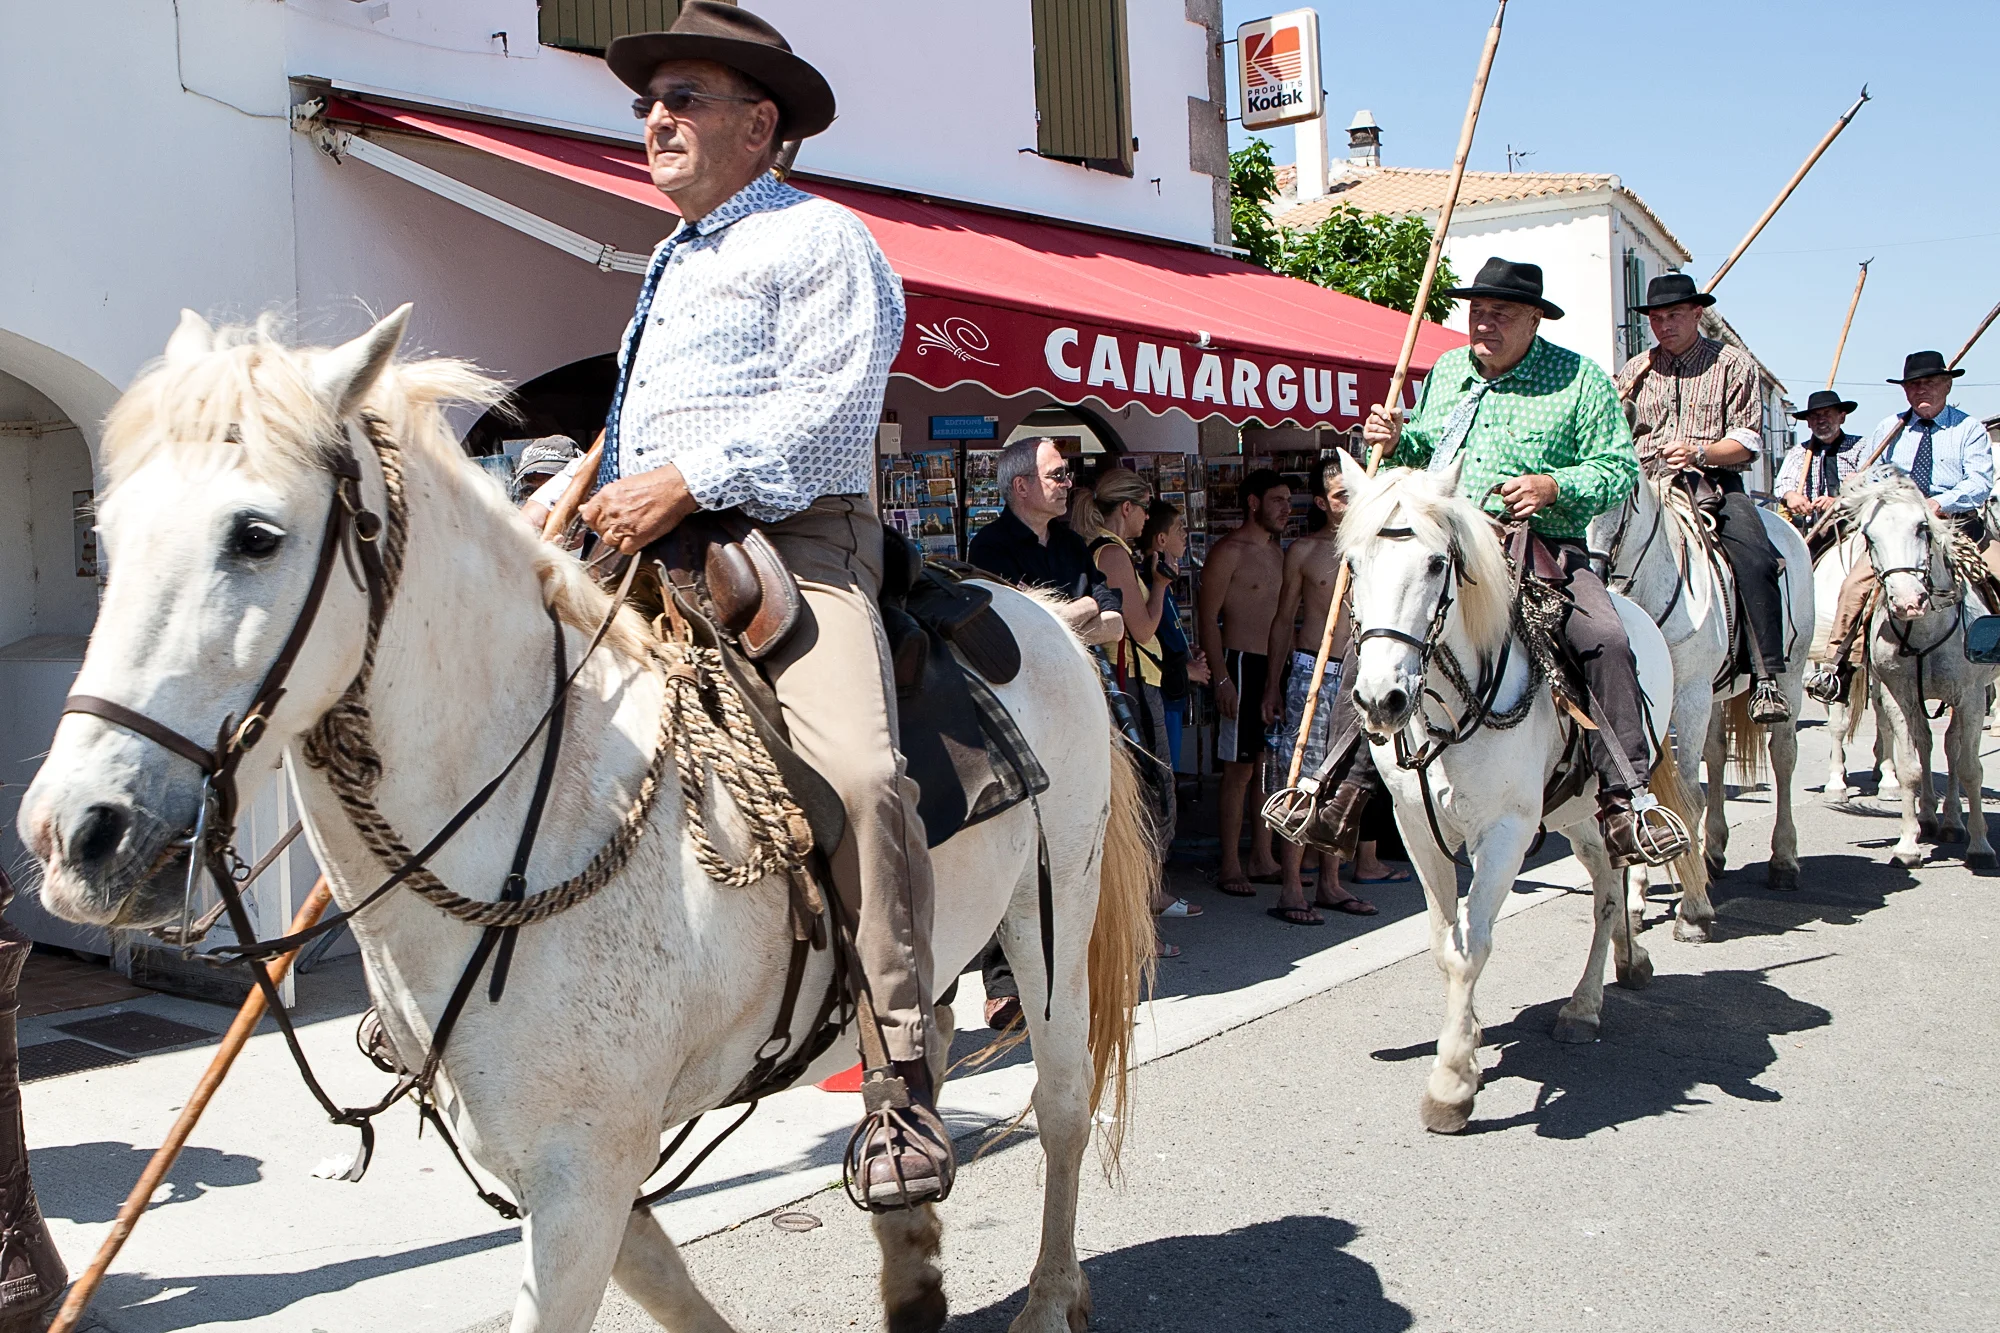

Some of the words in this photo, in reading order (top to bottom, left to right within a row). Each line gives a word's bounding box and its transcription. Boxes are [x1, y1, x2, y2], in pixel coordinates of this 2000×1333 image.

[1248, 80, 1303, 97] PRODUITS
[1248, 89, 1303, 113] Kodak
[1044, 327, 1360, 417] CAMARGUE
